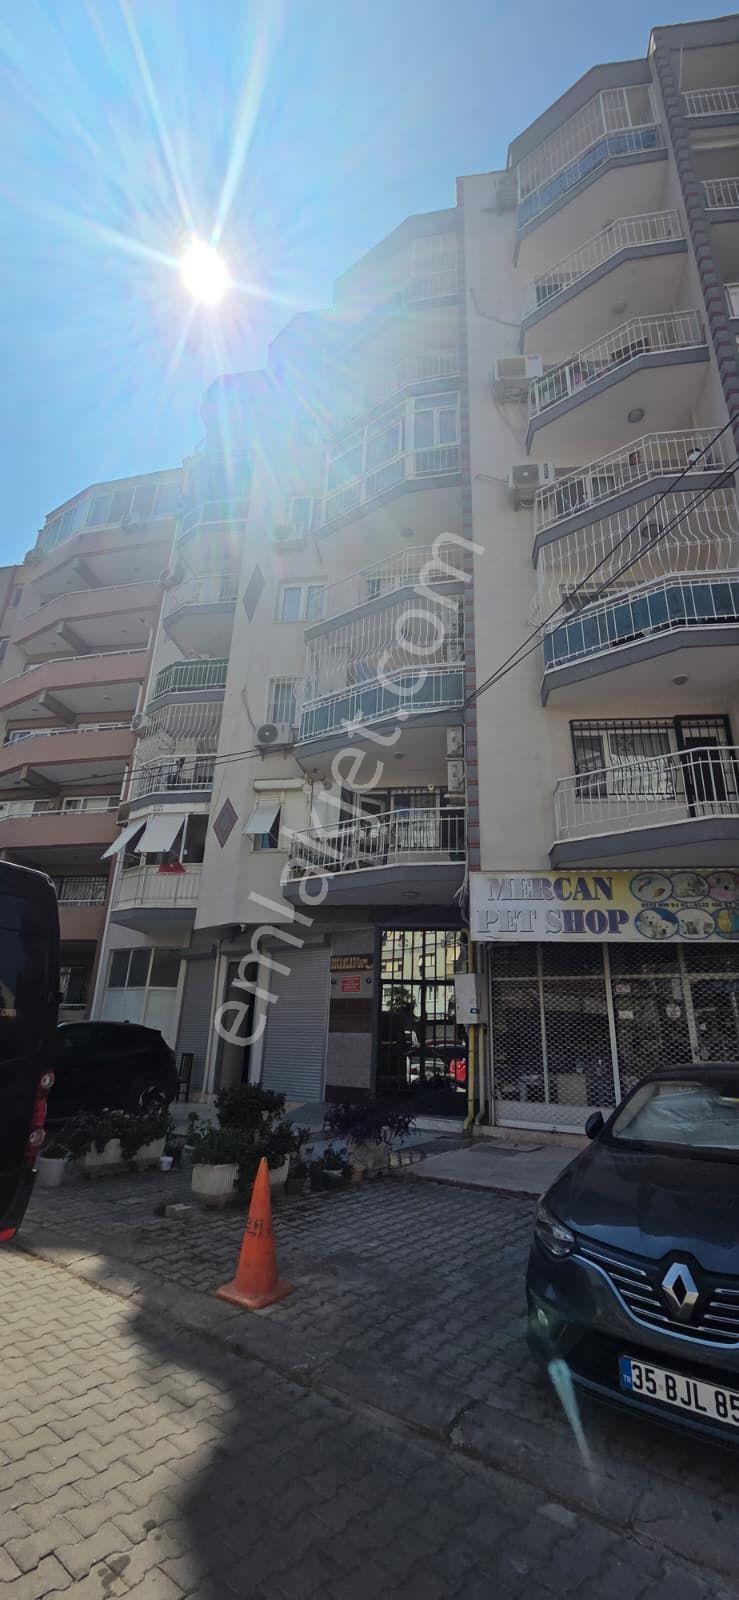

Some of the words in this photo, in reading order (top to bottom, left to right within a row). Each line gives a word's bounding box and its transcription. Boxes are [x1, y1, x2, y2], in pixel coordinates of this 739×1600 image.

[487, 877, 613, 901] MERCAN
[476, 910, 537, 934] PET
[546, 909, 630, 934] SHOP
[632, 1364, 657, 1395] 35
[664, 1374, 707, 1412] BJL
